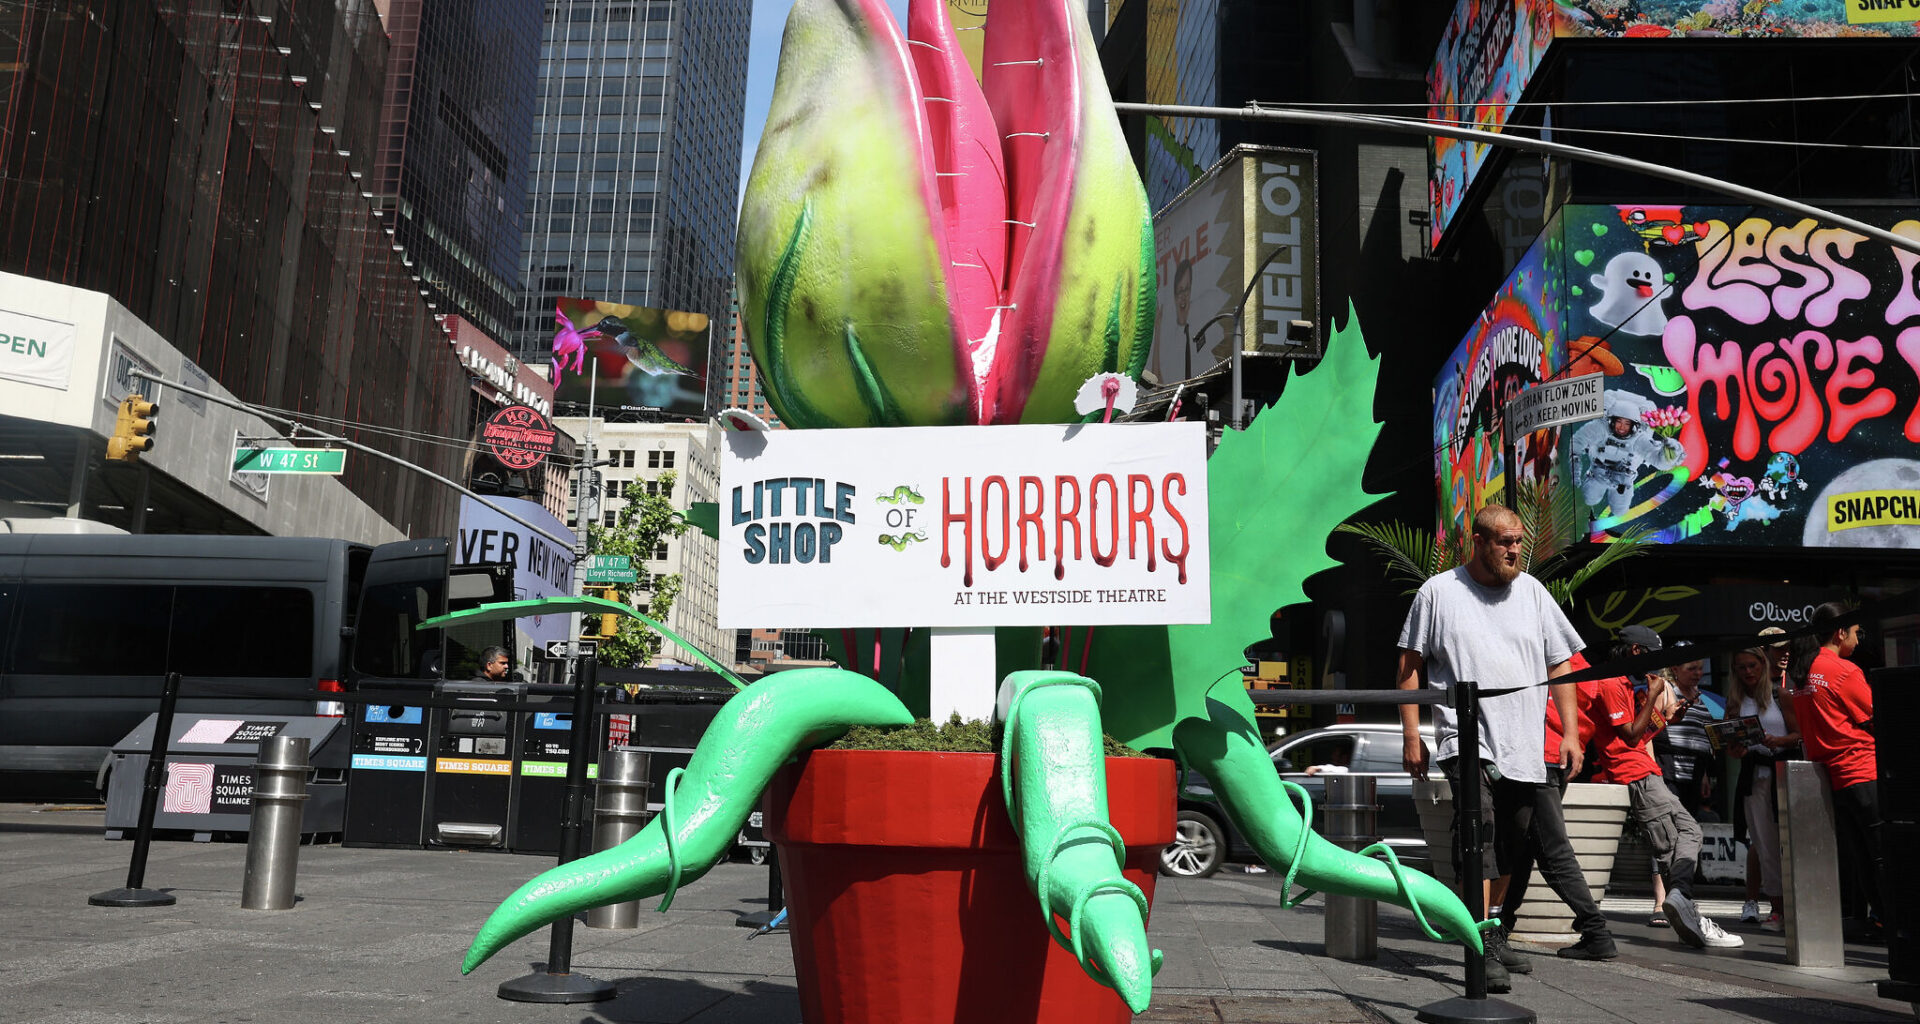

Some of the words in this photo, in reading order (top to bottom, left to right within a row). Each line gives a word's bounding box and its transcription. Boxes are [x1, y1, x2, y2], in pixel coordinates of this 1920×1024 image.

[1261, 161, 1303, 346] HELLO!
[1470, 345, 1490, 413] LIKES
[1493, 325, 1518, 371] MORE
[1518, 326, 1544, 380] LOVE
[1545, 385, 1569, 403] FLOW
[1572, 379, 1597, 397] ZONE
[505, 410, 537, 425] HOT
[1537, 406, 1558, 423] KEEP
[1561, 398, 1597, 417] MOVING
[486, 438, 522, 448] ORIGINAL
[524, 443, 552, 452] GLAZED
[260, 453, 274, 468] W
[279, 453, 298, 468] 47
[303, 453, 319, 468] St
[501, 447, 536, 464] NOW
[731, 476, 856, 527] LITTLE
[886, 508, 917, 528] OF
[1834, 495, 1920, 525] SNAPCH
[940, 472, 1190, 588] HORRORS
[743, 521, 843, 565] SHOP
[528, 536, 551, 581] NEW
[551, 548, 571, 595] YORK
[597, 557, 606, 568] W
[608, 557, 619, 568] 47
[589, 569, 606, 579] Lloyd
[608, 569, 634, 578] Richards
[954, 591, 974, 605] AT
[978, 591, 1008, 605] THE
[1012, 590, 1092, 604] WESTSIDE
[1097, 589, 1166, 603] THEATRE
[1749, 601, 1802, 622] Olive
[354, 757, 384, 767] TIMES
[386, 759, 425, 769] SQUARE
[439, 761, 470, 771] TIMES
[471, 763, 510, 773] SQUARE
[524, 764, 554, 774] TIMES
[220, 774, 251, 785] TIMES
[215, 785, 254, 797] SQUARE
[216, 797, 251, 805] ALLIANCE
